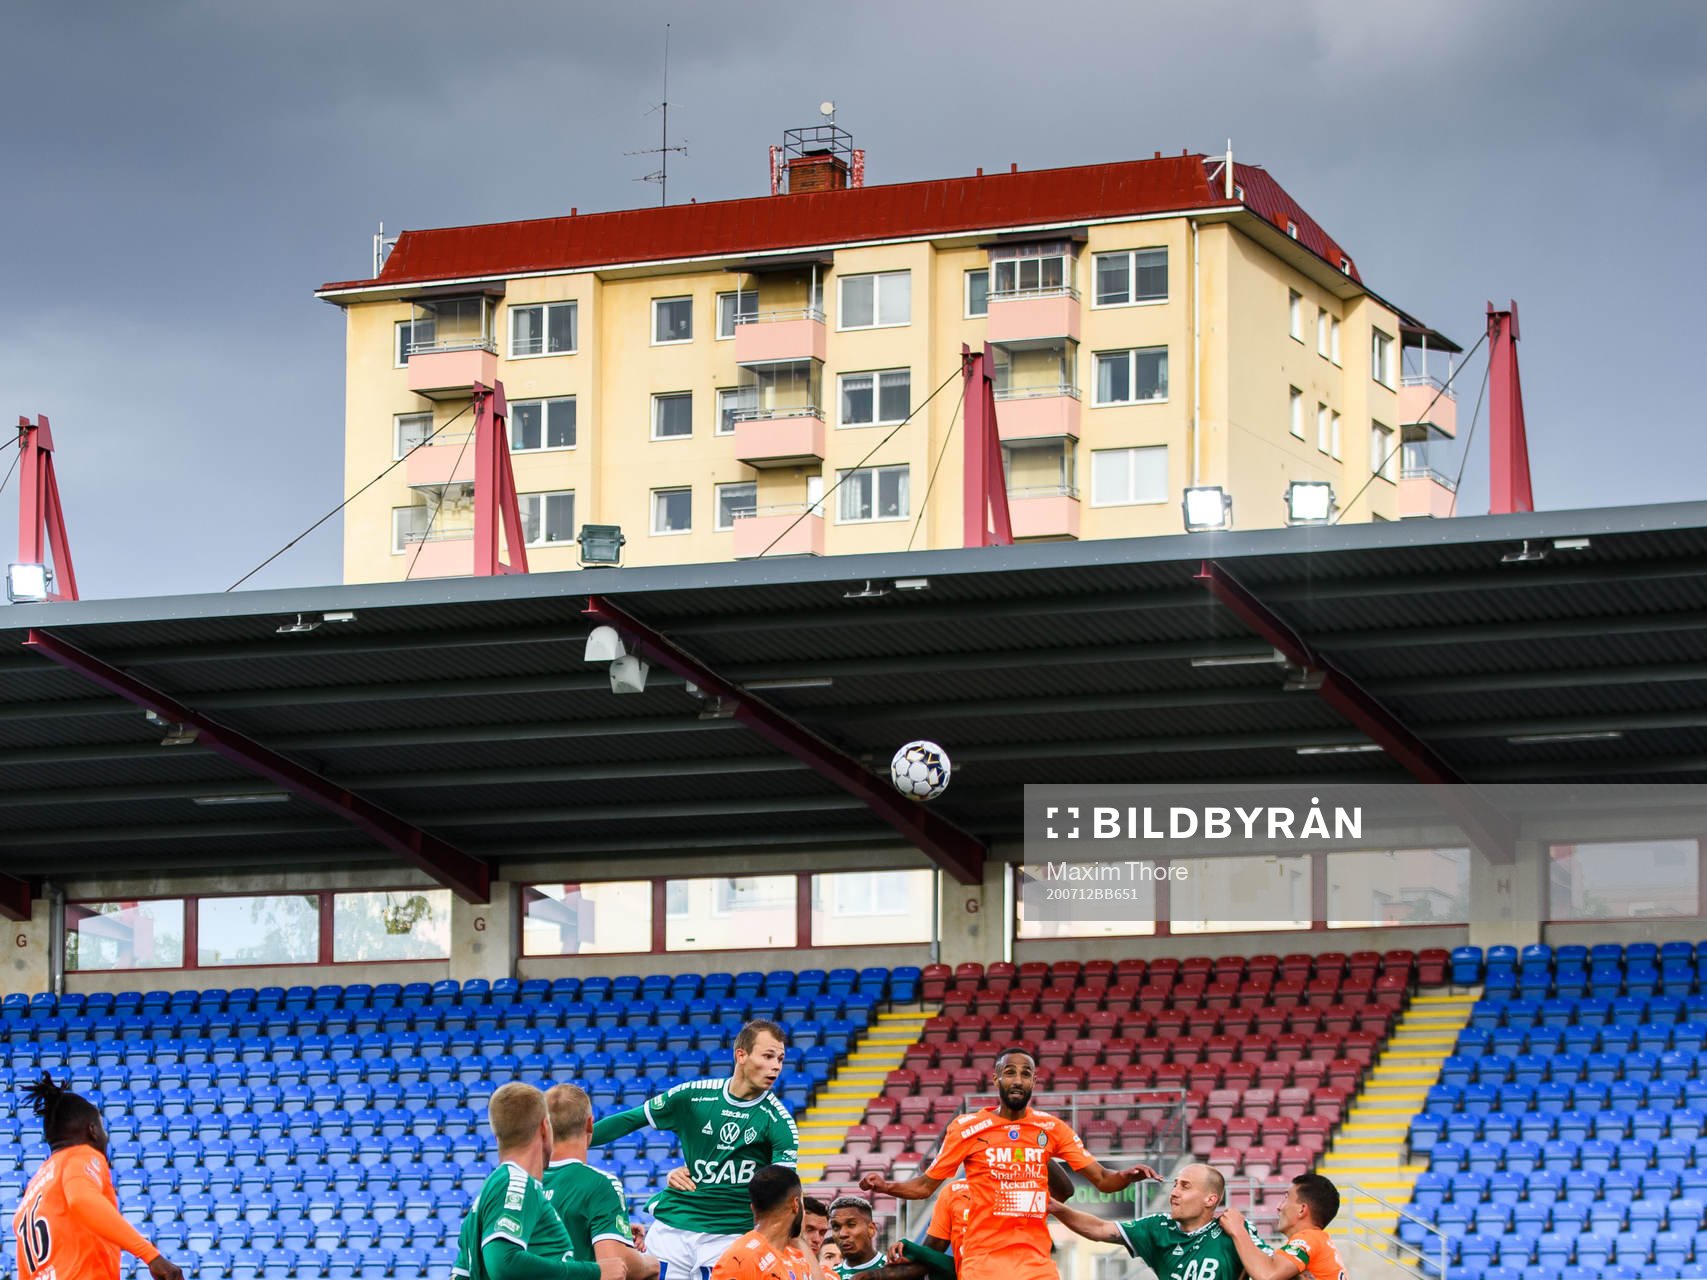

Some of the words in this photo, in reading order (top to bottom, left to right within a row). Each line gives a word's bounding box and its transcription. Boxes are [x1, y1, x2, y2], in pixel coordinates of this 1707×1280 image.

[965, 898, 979, 914] G
[473, 916, 486, 932] G
[15, 933, 28, 948] G
[985, 1147, 1045, 1163] SMART
[691, 1159, 757, 1185] SSAB
[1000, 1180, 1039, 1190] Rekarn
[18, 1191, 52, 1274] 16
